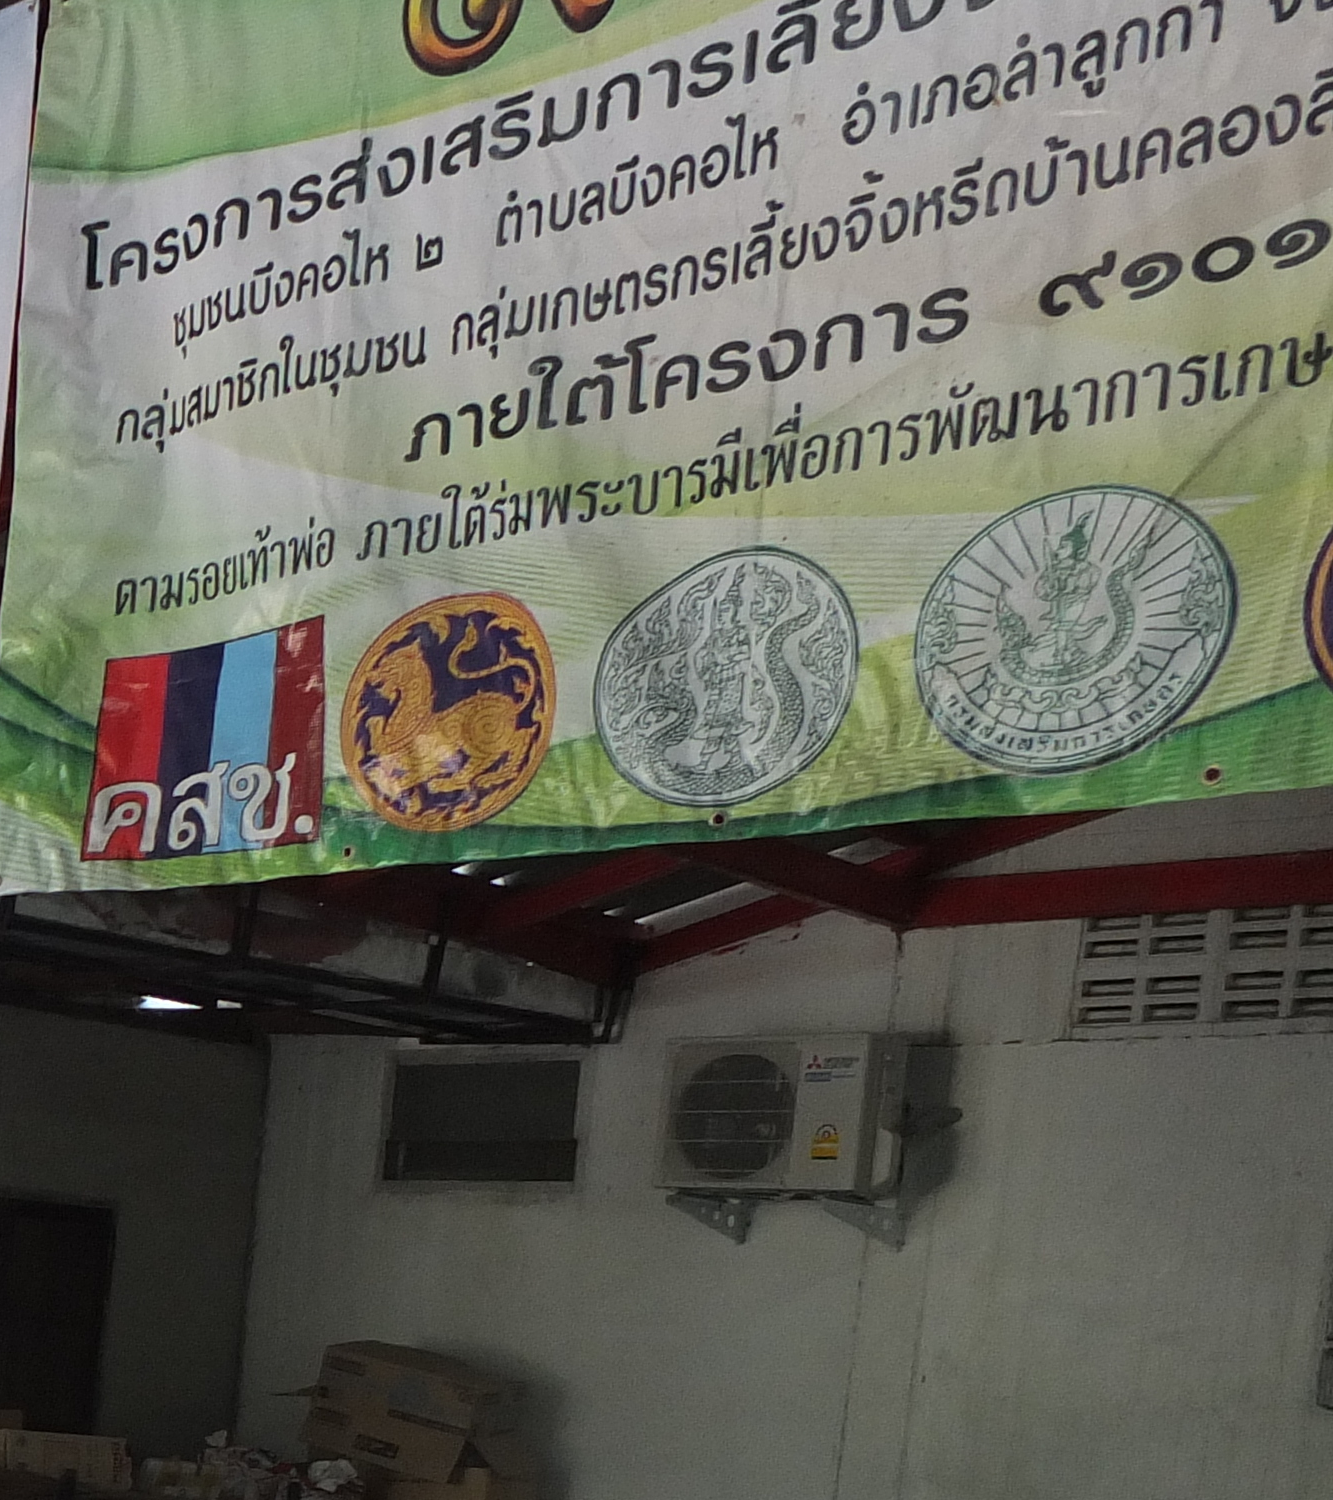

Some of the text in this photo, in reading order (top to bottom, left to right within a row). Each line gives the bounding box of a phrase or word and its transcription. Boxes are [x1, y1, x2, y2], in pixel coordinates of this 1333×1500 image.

[172, 0, 1224, 359] ชุมชนบึงคอไห ๒ ตำบลบึงคอไห อำเภอลำลูกกา
[117, 325, 427, 453] กลุ่มสมาชิกในชุมชน
[404, 219, 1332, 463] ภายใต้โครงการ ๙๑๐๑
[115, 518, 334, 616] ตามรอยเท้าพ่อ
[87, 751, 315, 856] คสช.
